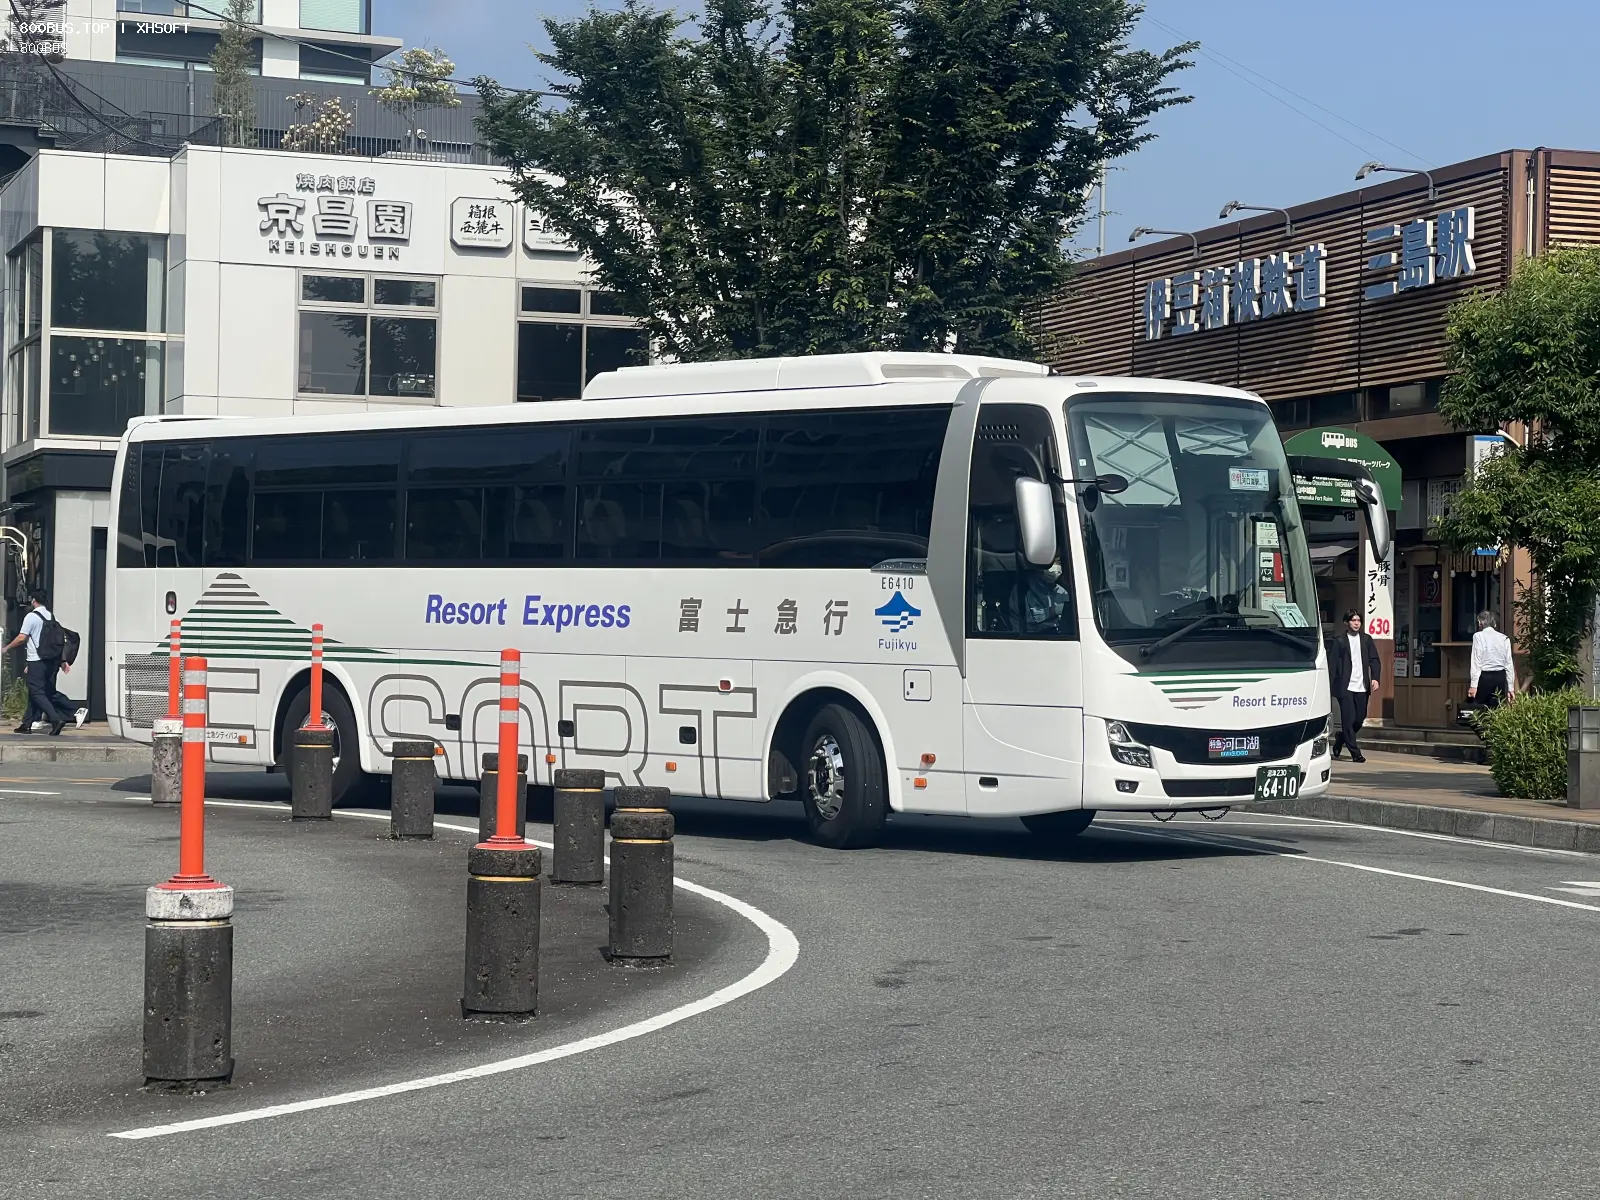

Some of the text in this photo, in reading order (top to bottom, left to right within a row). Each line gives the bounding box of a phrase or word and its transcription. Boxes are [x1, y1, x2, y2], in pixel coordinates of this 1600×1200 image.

[296, 173, 375, 195] 焼肉飯店
[257, 193, 413, 243] 京昌園
[269, 240, 400, 261] KEISHOUEN
[1141, 206, 1476, 341] 伊豆箱根鉄道 三島駅
[1346, 437, 1358, 448] BUS
[881, 576, 914, 590] E6410
[1368, 570, 1377, 614] ラーメン
[425, 594, 631, 633] Resort Express
[678, 598, 848, 636] 富士急行
[1368, 618, 1390, 635] 630
[878, 639, 917, 652] Fujikyu
[1232, 695, 1308, 708] Resort Express
[1222, 736, 1260, 751] 河口湖
